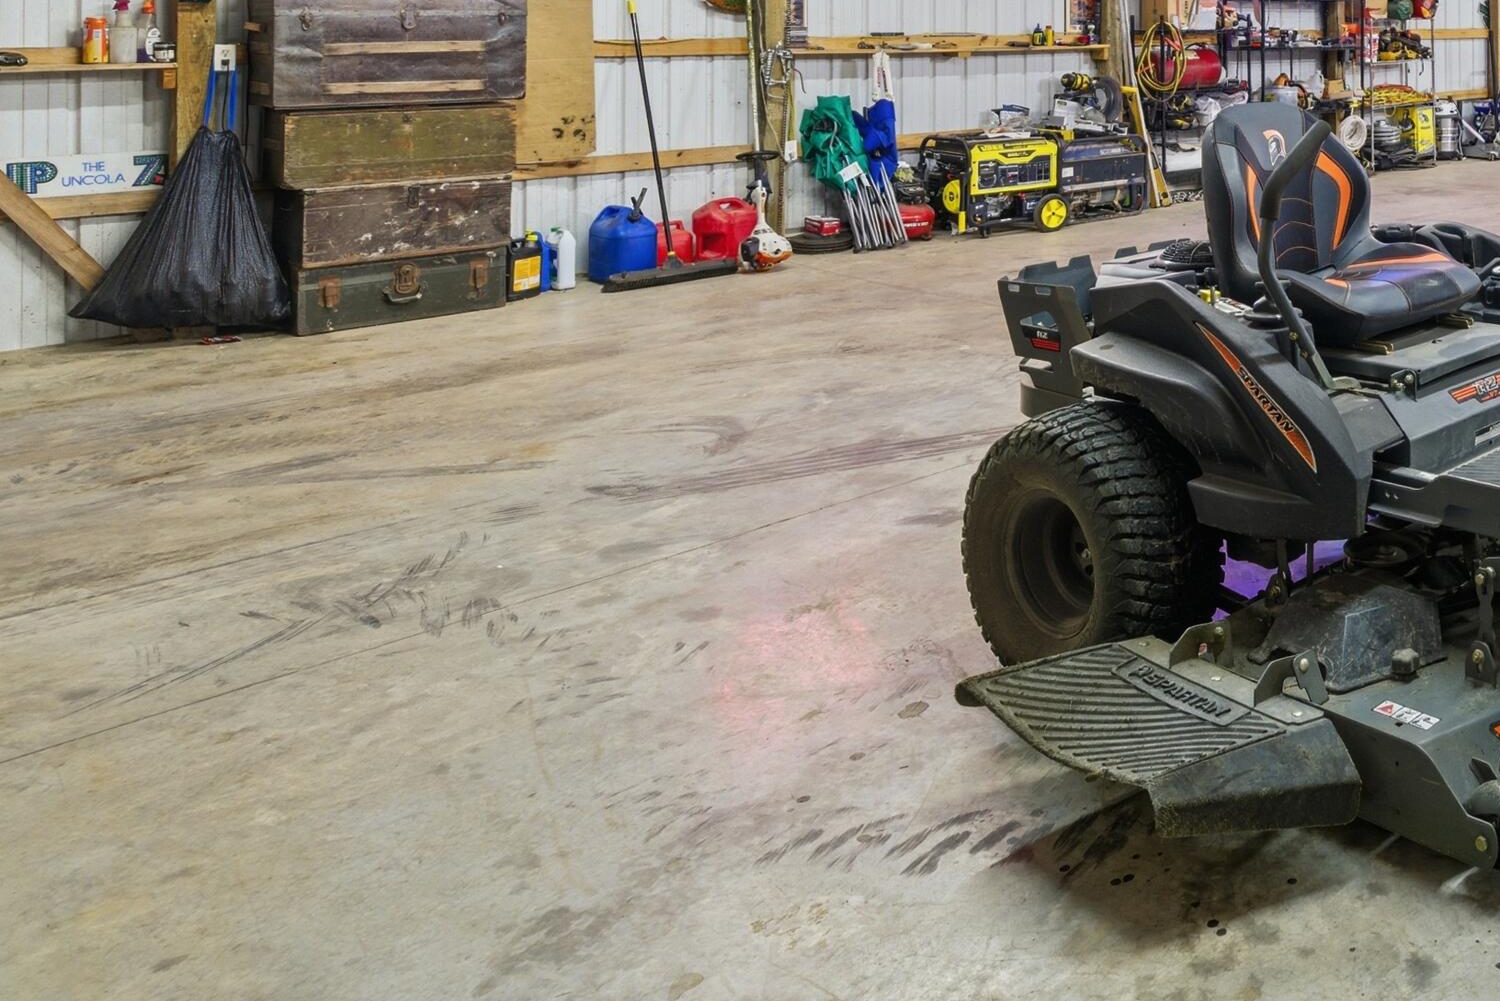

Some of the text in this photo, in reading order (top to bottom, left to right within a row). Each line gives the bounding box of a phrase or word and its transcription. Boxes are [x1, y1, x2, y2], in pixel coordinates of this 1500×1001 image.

[61, 173, 126, 188] UNCOLA
[82, 161, 106, 172] THE
[1237, 366, 1294, 432] SPARTAN
[1148, 671, 1232, 719] SPARTAN
